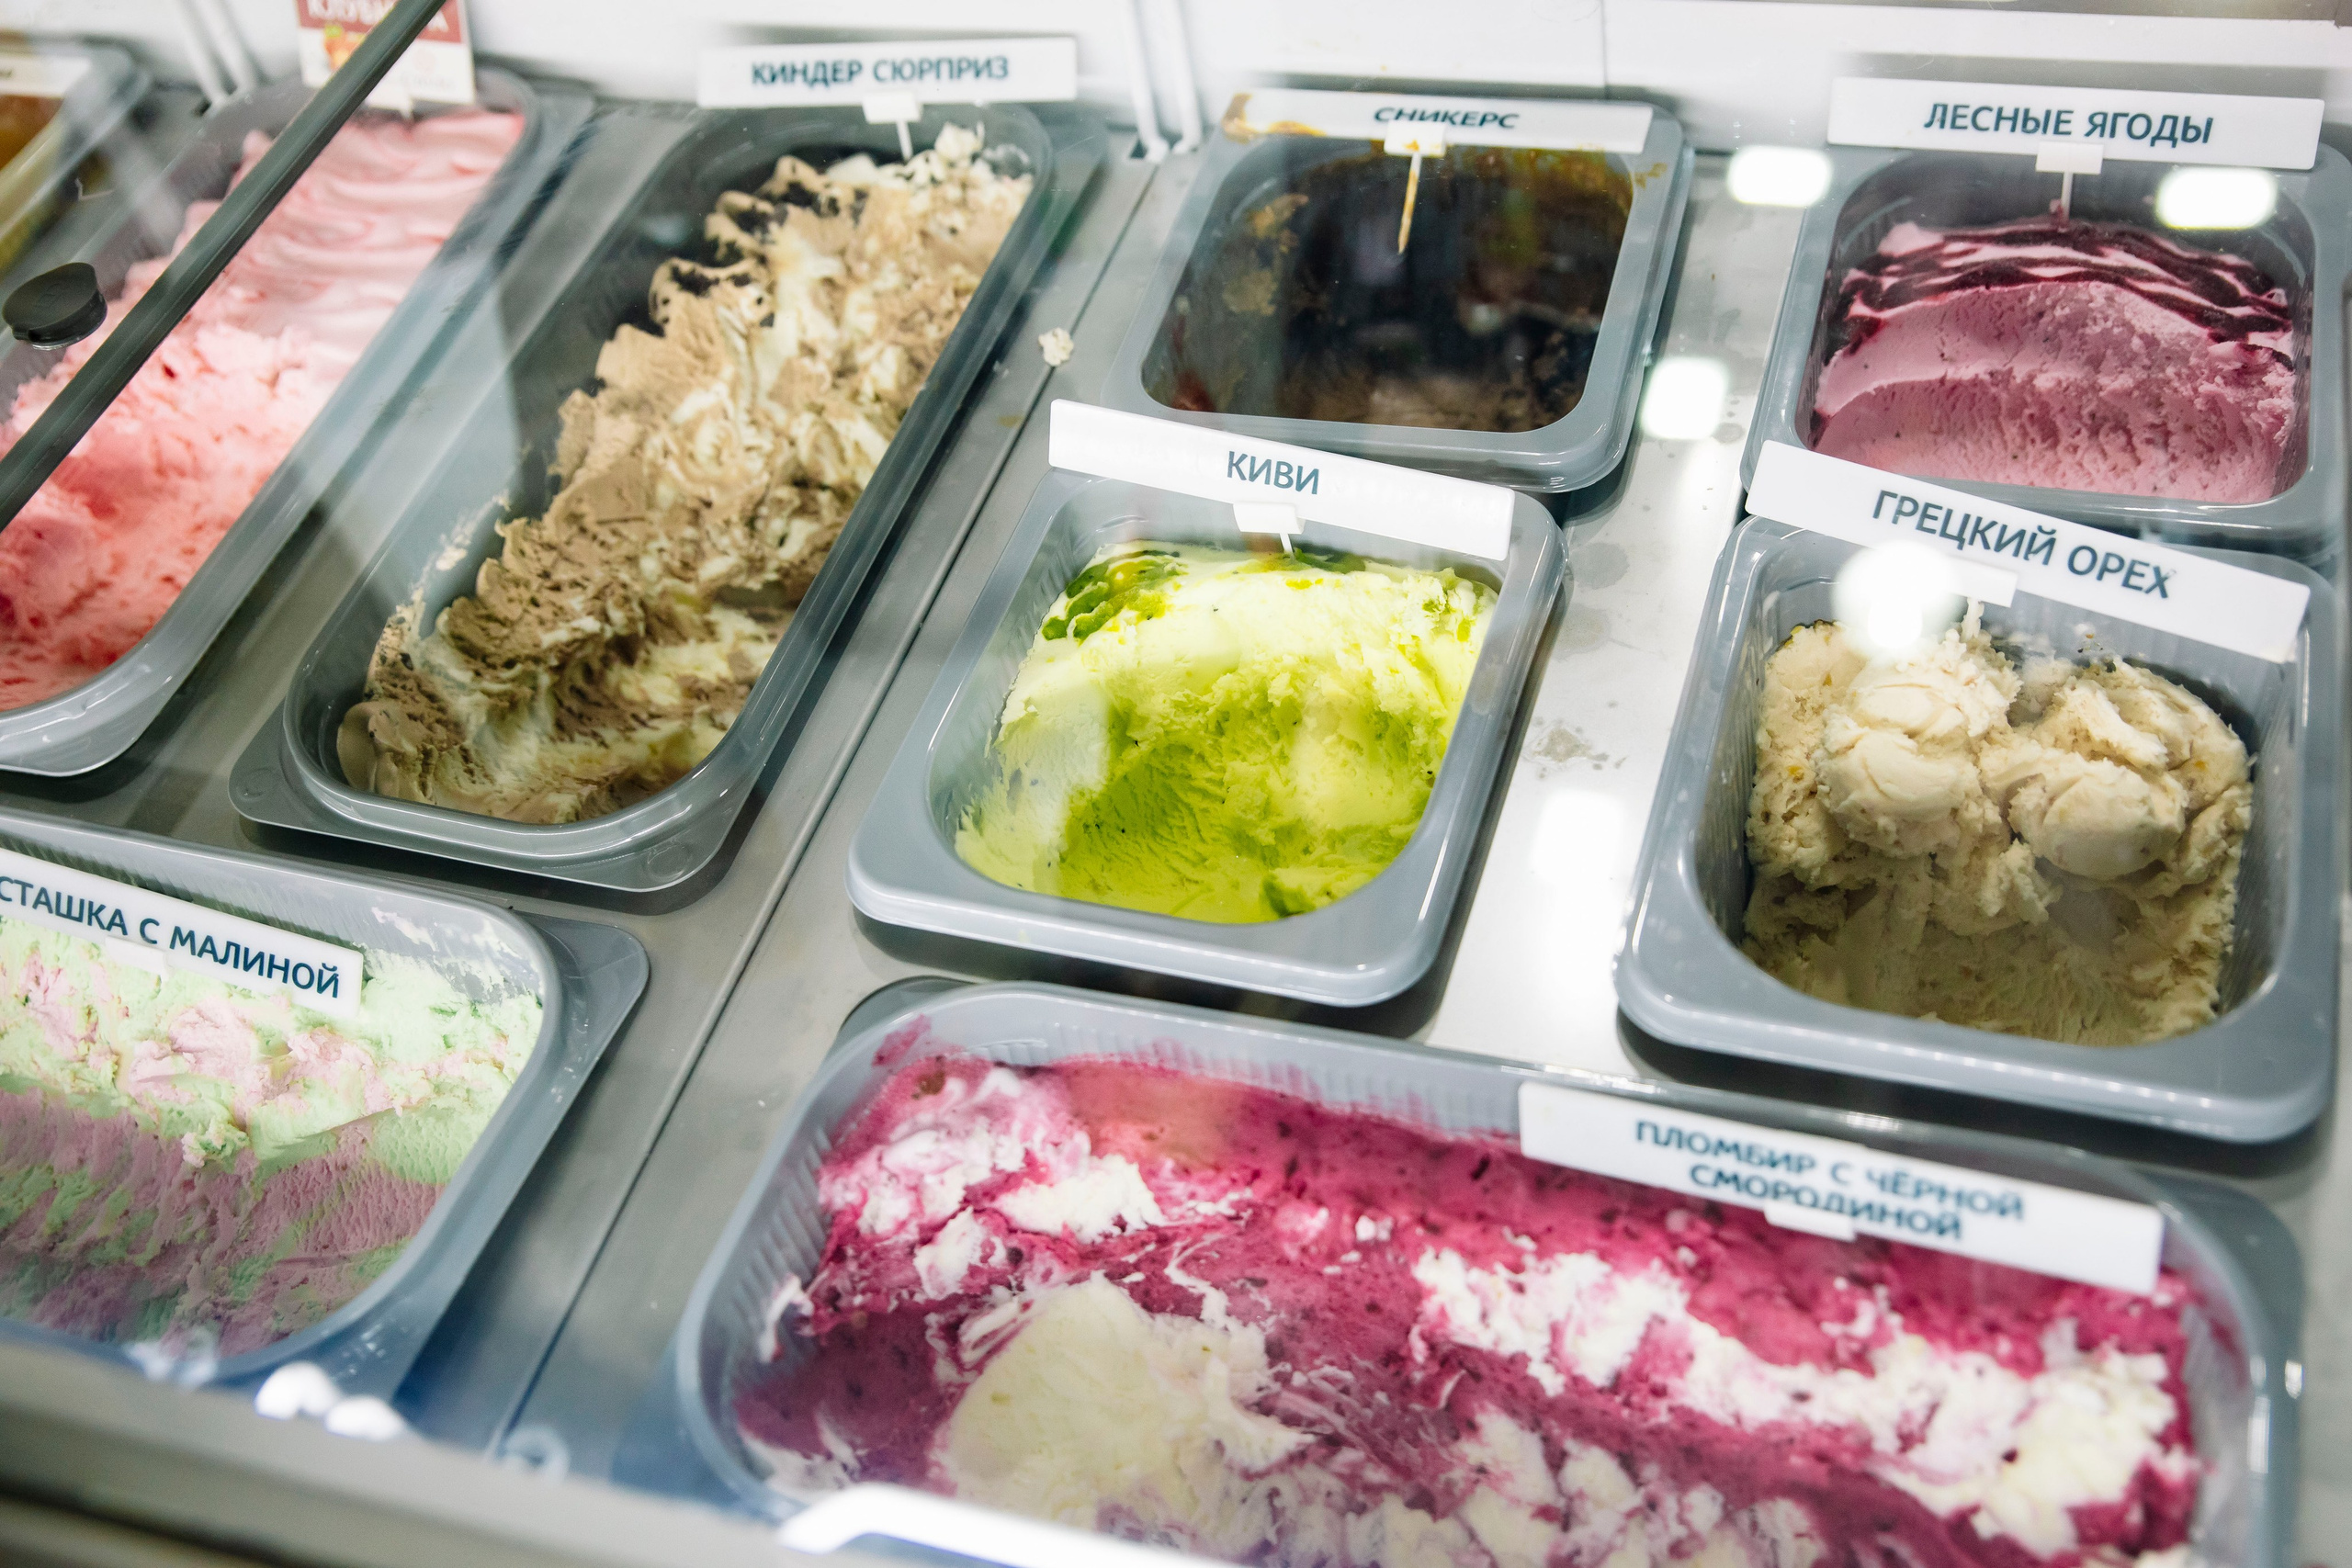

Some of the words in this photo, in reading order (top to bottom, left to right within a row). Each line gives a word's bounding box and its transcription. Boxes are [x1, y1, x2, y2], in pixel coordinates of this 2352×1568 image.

[752, 60, 863, 88] КИНДЕР
[873, 55, 1009, 83] СЮРПРИЗ
[1374, 107, 1520, 129] СНИКЕРС
[1924, 102, 2074, 136] ЛЕСНЫЕ
[2084, 110, 2213, 148] ЯГОДЫ
[1227, 450, 1320, 495] КИВИ
[1872, 490, 2057, 566] ГРЕЦКИЙ
[2067, 545, 2177, 600] ОРЕХ
[139, 918, 160, 945] С
[169, 925, 340, 999] МАЛИНОЙ
[1636, 1120, 1816, 1174] ПЛОМБИР
[1830, 1161, 1851, 1185] С
[1866, 1167, 2024, 1221] ЧЁРНОЙ
[1690, 1164, 1962, 1238] СМОРОДИНОЙ
